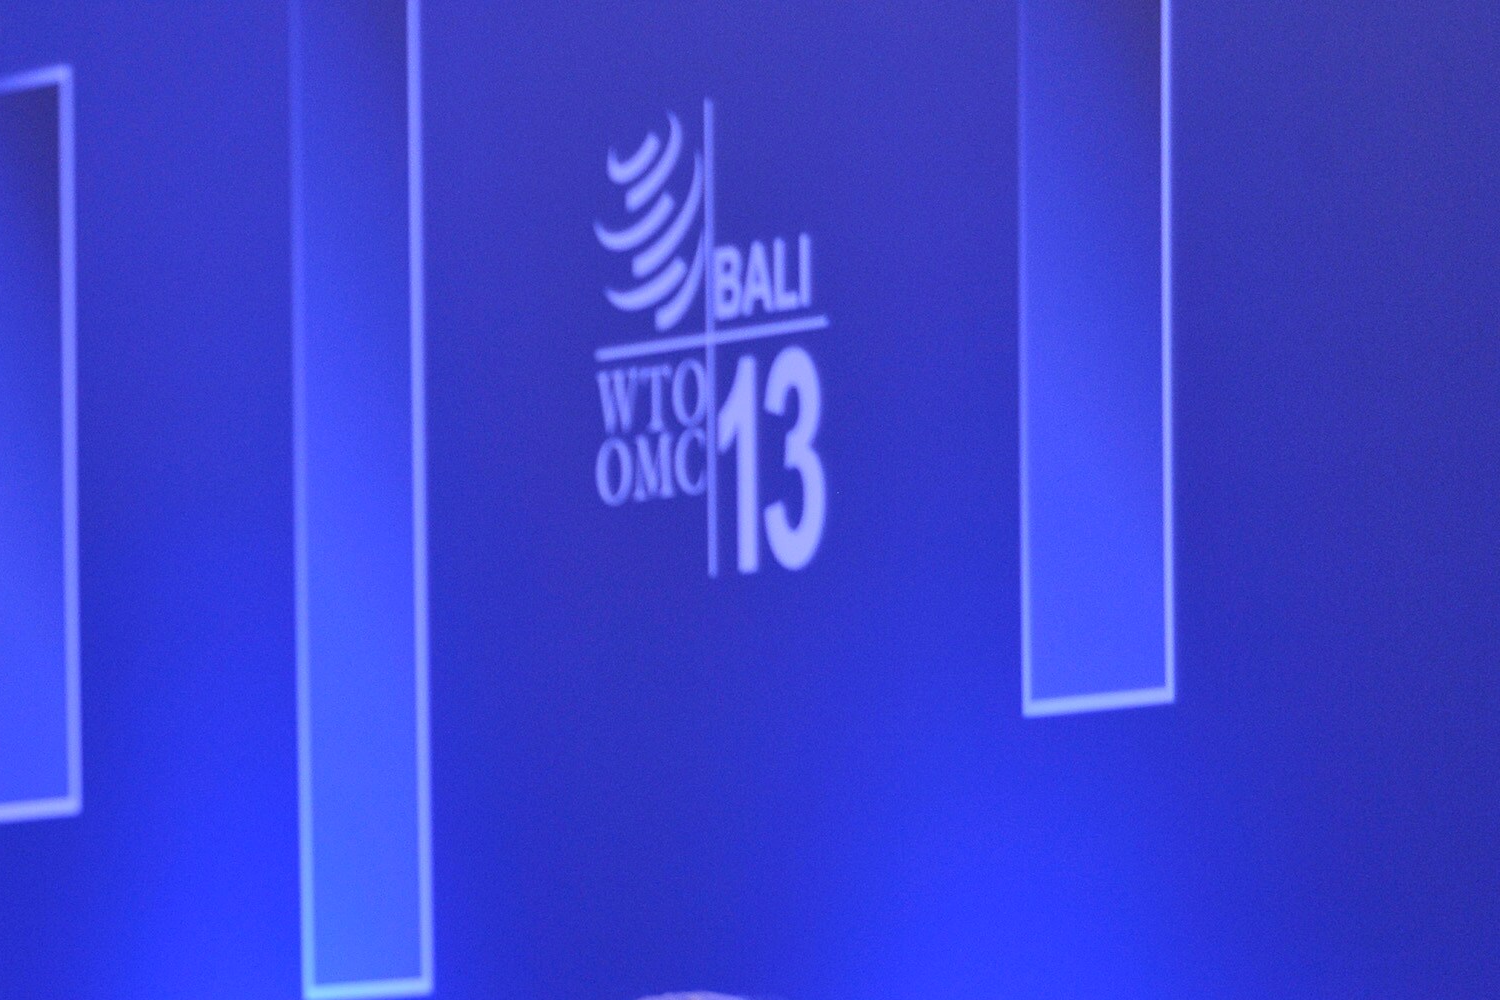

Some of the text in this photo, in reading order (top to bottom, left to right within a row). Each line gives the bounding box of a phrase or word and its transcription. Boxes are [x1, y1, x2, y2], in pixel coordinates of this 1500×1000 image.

[714, 232, 812, 321] BALI
[597, 358, 706, 435] WTO
[595, 428, 706, 507] OMC
[718, 346, 826, 574] 13
